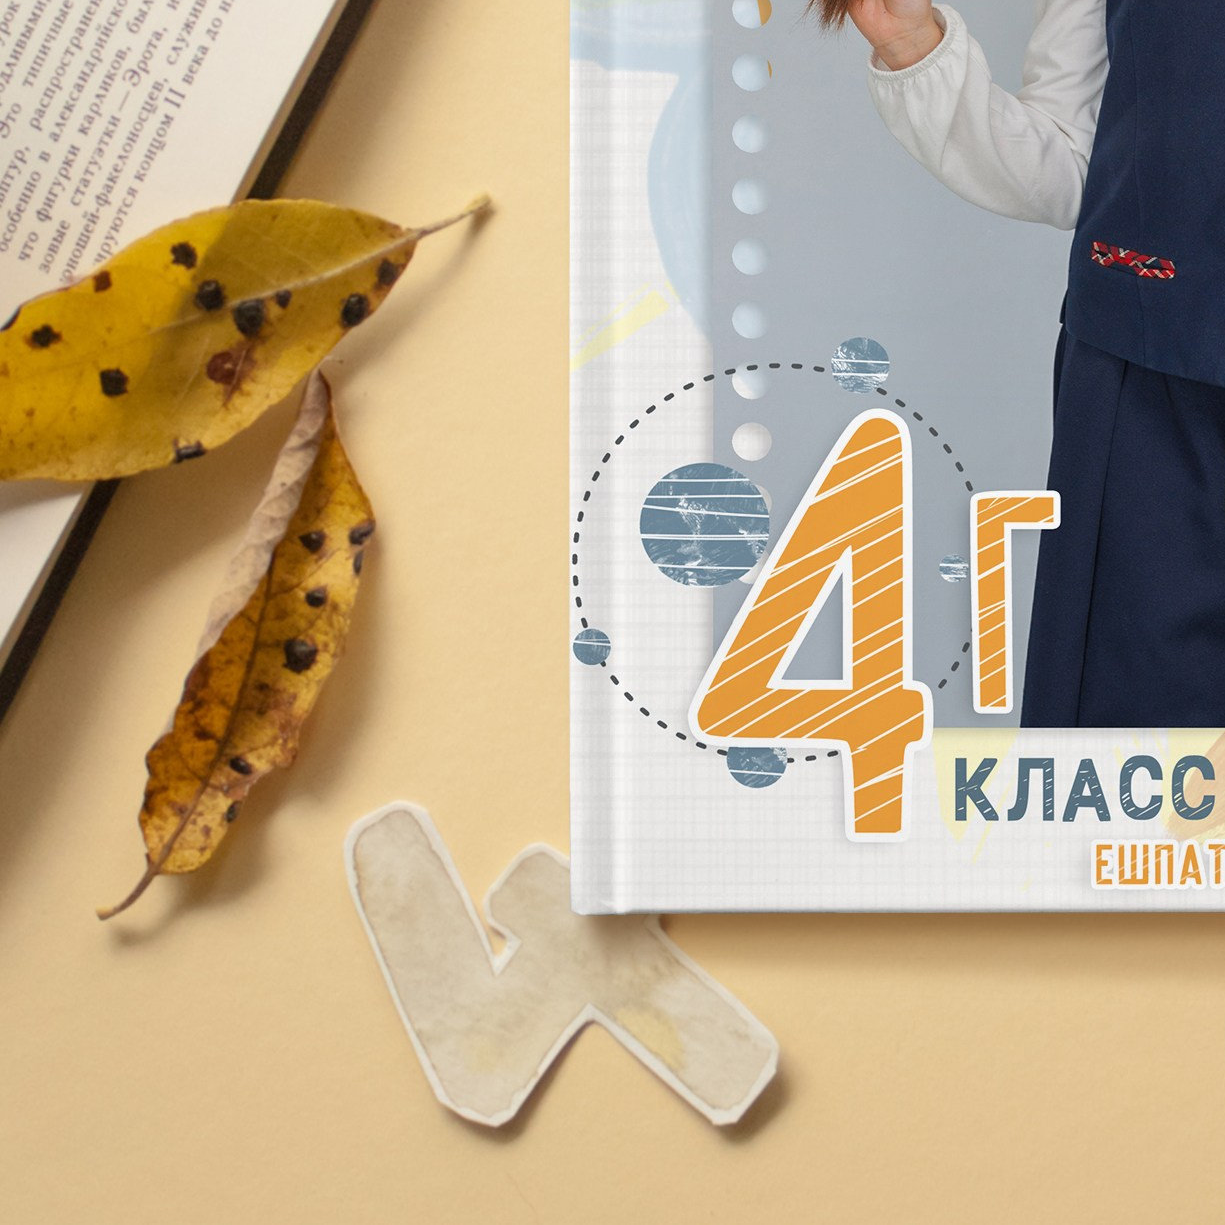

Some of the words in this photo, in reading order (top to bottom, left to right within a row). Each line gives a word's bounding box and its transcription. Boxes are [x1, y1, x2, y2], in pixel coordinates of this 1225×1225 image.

[1, 0, 21, 47] рок
[21, 0, 74, 88] типичные
[38, 219, 71, 274] зовые
[70, 114, 121, 207] статуэтки
[121, 27, 169, 88] Эрота,
[133, 113, 175, 183] концом
[163, 87, 186, 110] II
[181, 44, 210, 86] века
[205, 17, 223, 42] до
[1, 170, 42, 253] особенно
[38, 150, 52, 163] в
[17, 231, 40, 261] что
[35, 143, 81, 223] фигурки
[76, 46, 132, 137] карликов,
[954, 754, 1216, 823] КЛАСС
